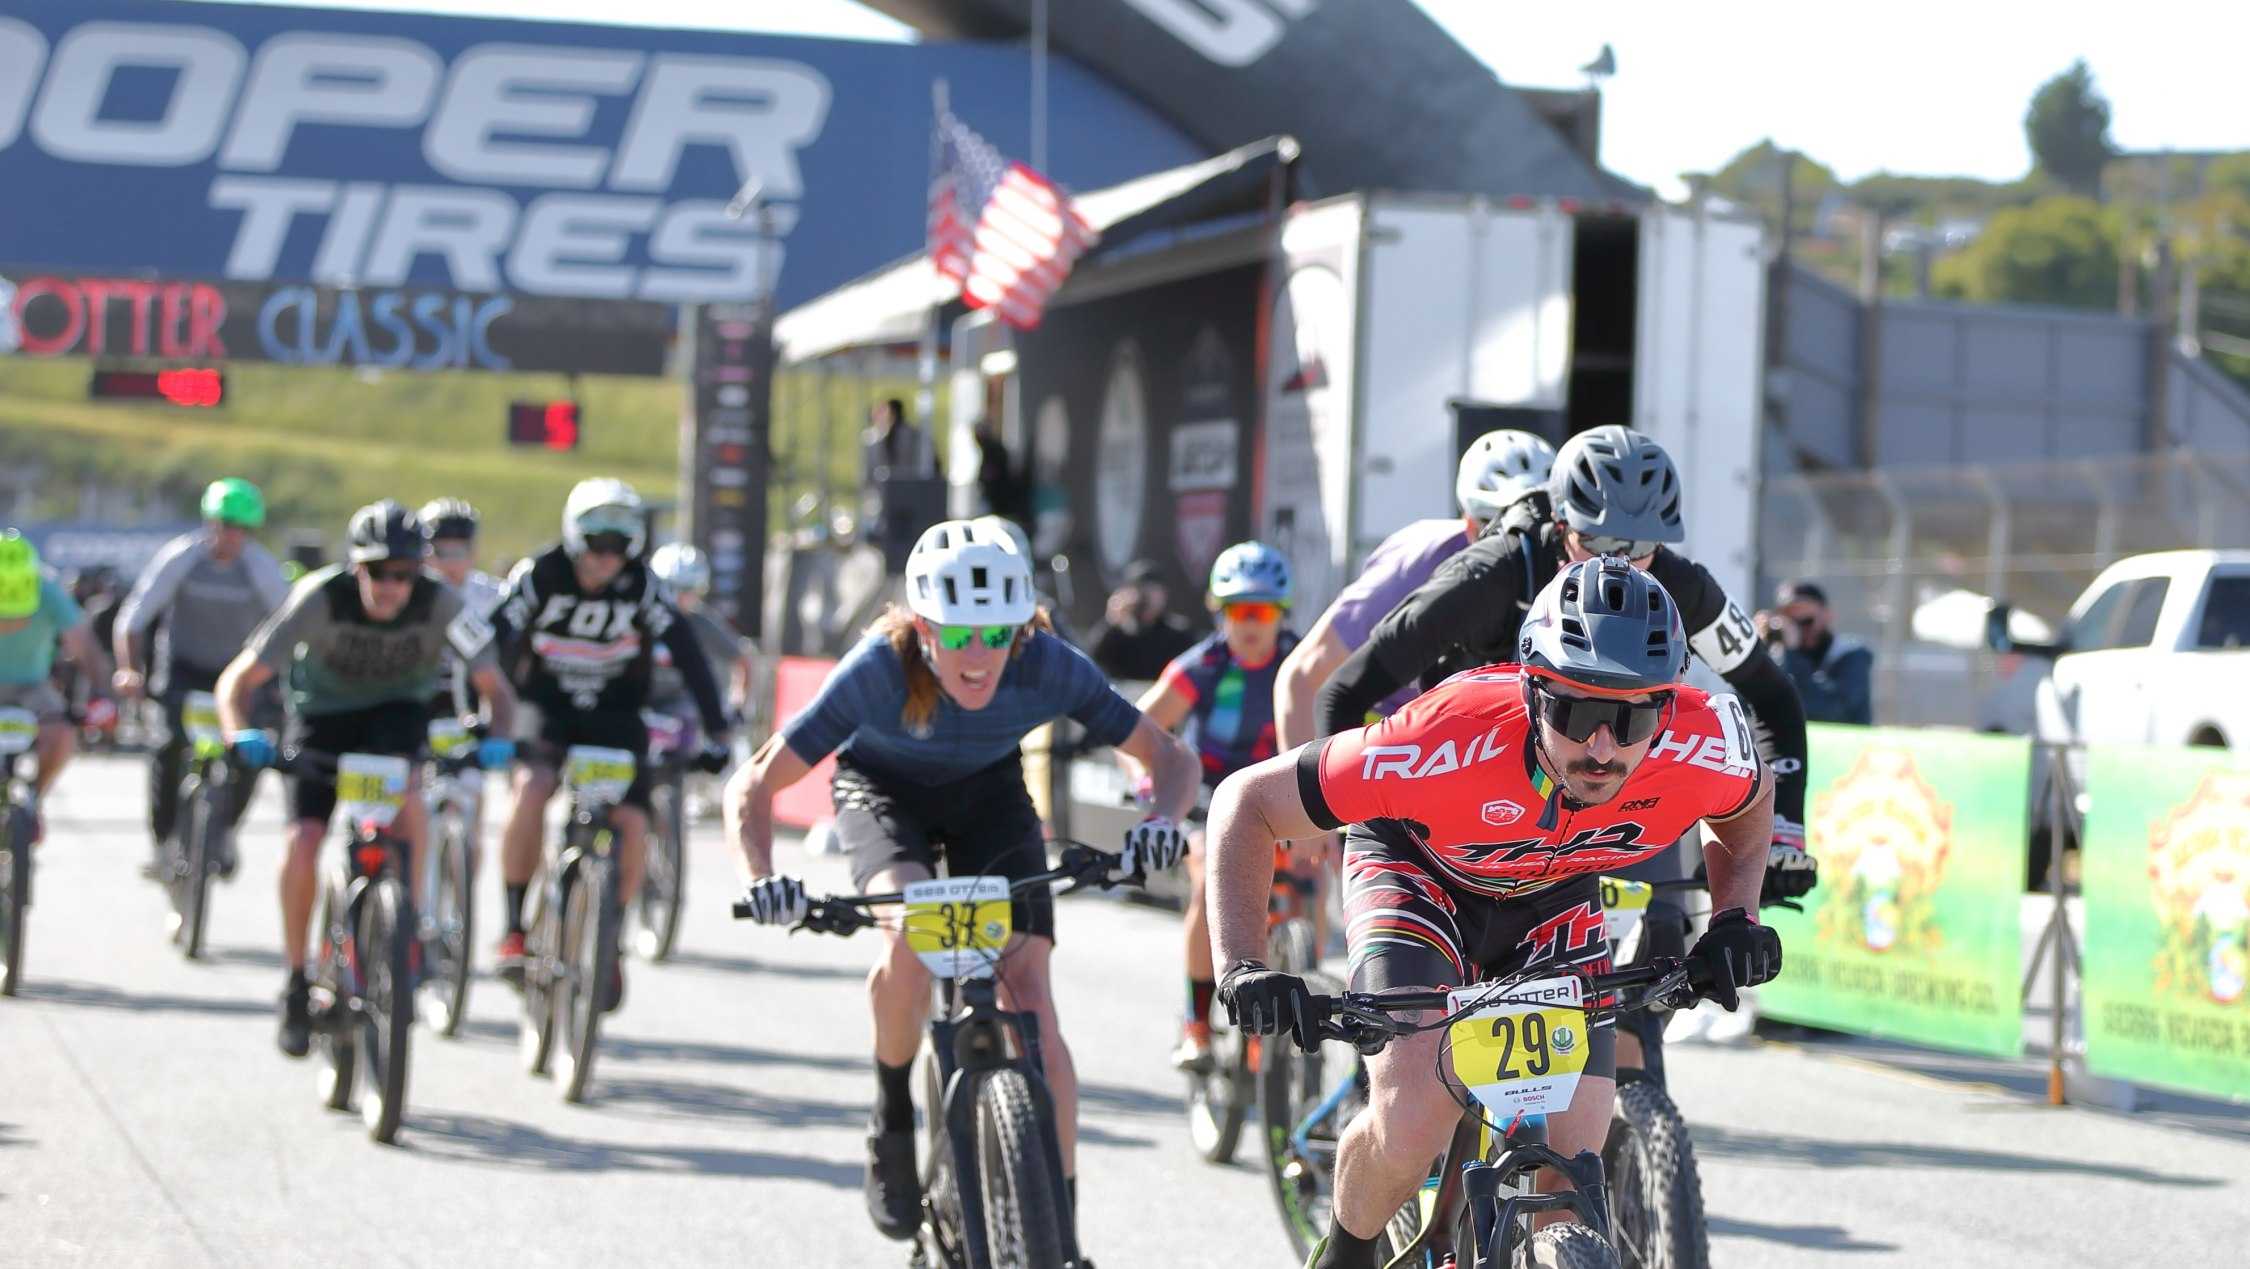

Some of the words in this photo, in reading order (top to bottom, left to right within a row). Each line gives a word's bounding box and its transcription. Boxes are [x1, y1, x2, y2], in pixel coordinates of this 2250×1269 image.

[0, 14, 835, 195] OPER
[204, 172, 800, 306] TIRES
[13, 274, 229, 359] OTTER
[256, 286, 519, 374] CLASSIC
[534, 593, 640, 641] FOX
[1715, 601, 1754, 657] 48
[1359, 726, 1511, 780] TRAIL
[1648, 729, 1751, 779] HE
[1491, 1012, 1551, 1081] 29
